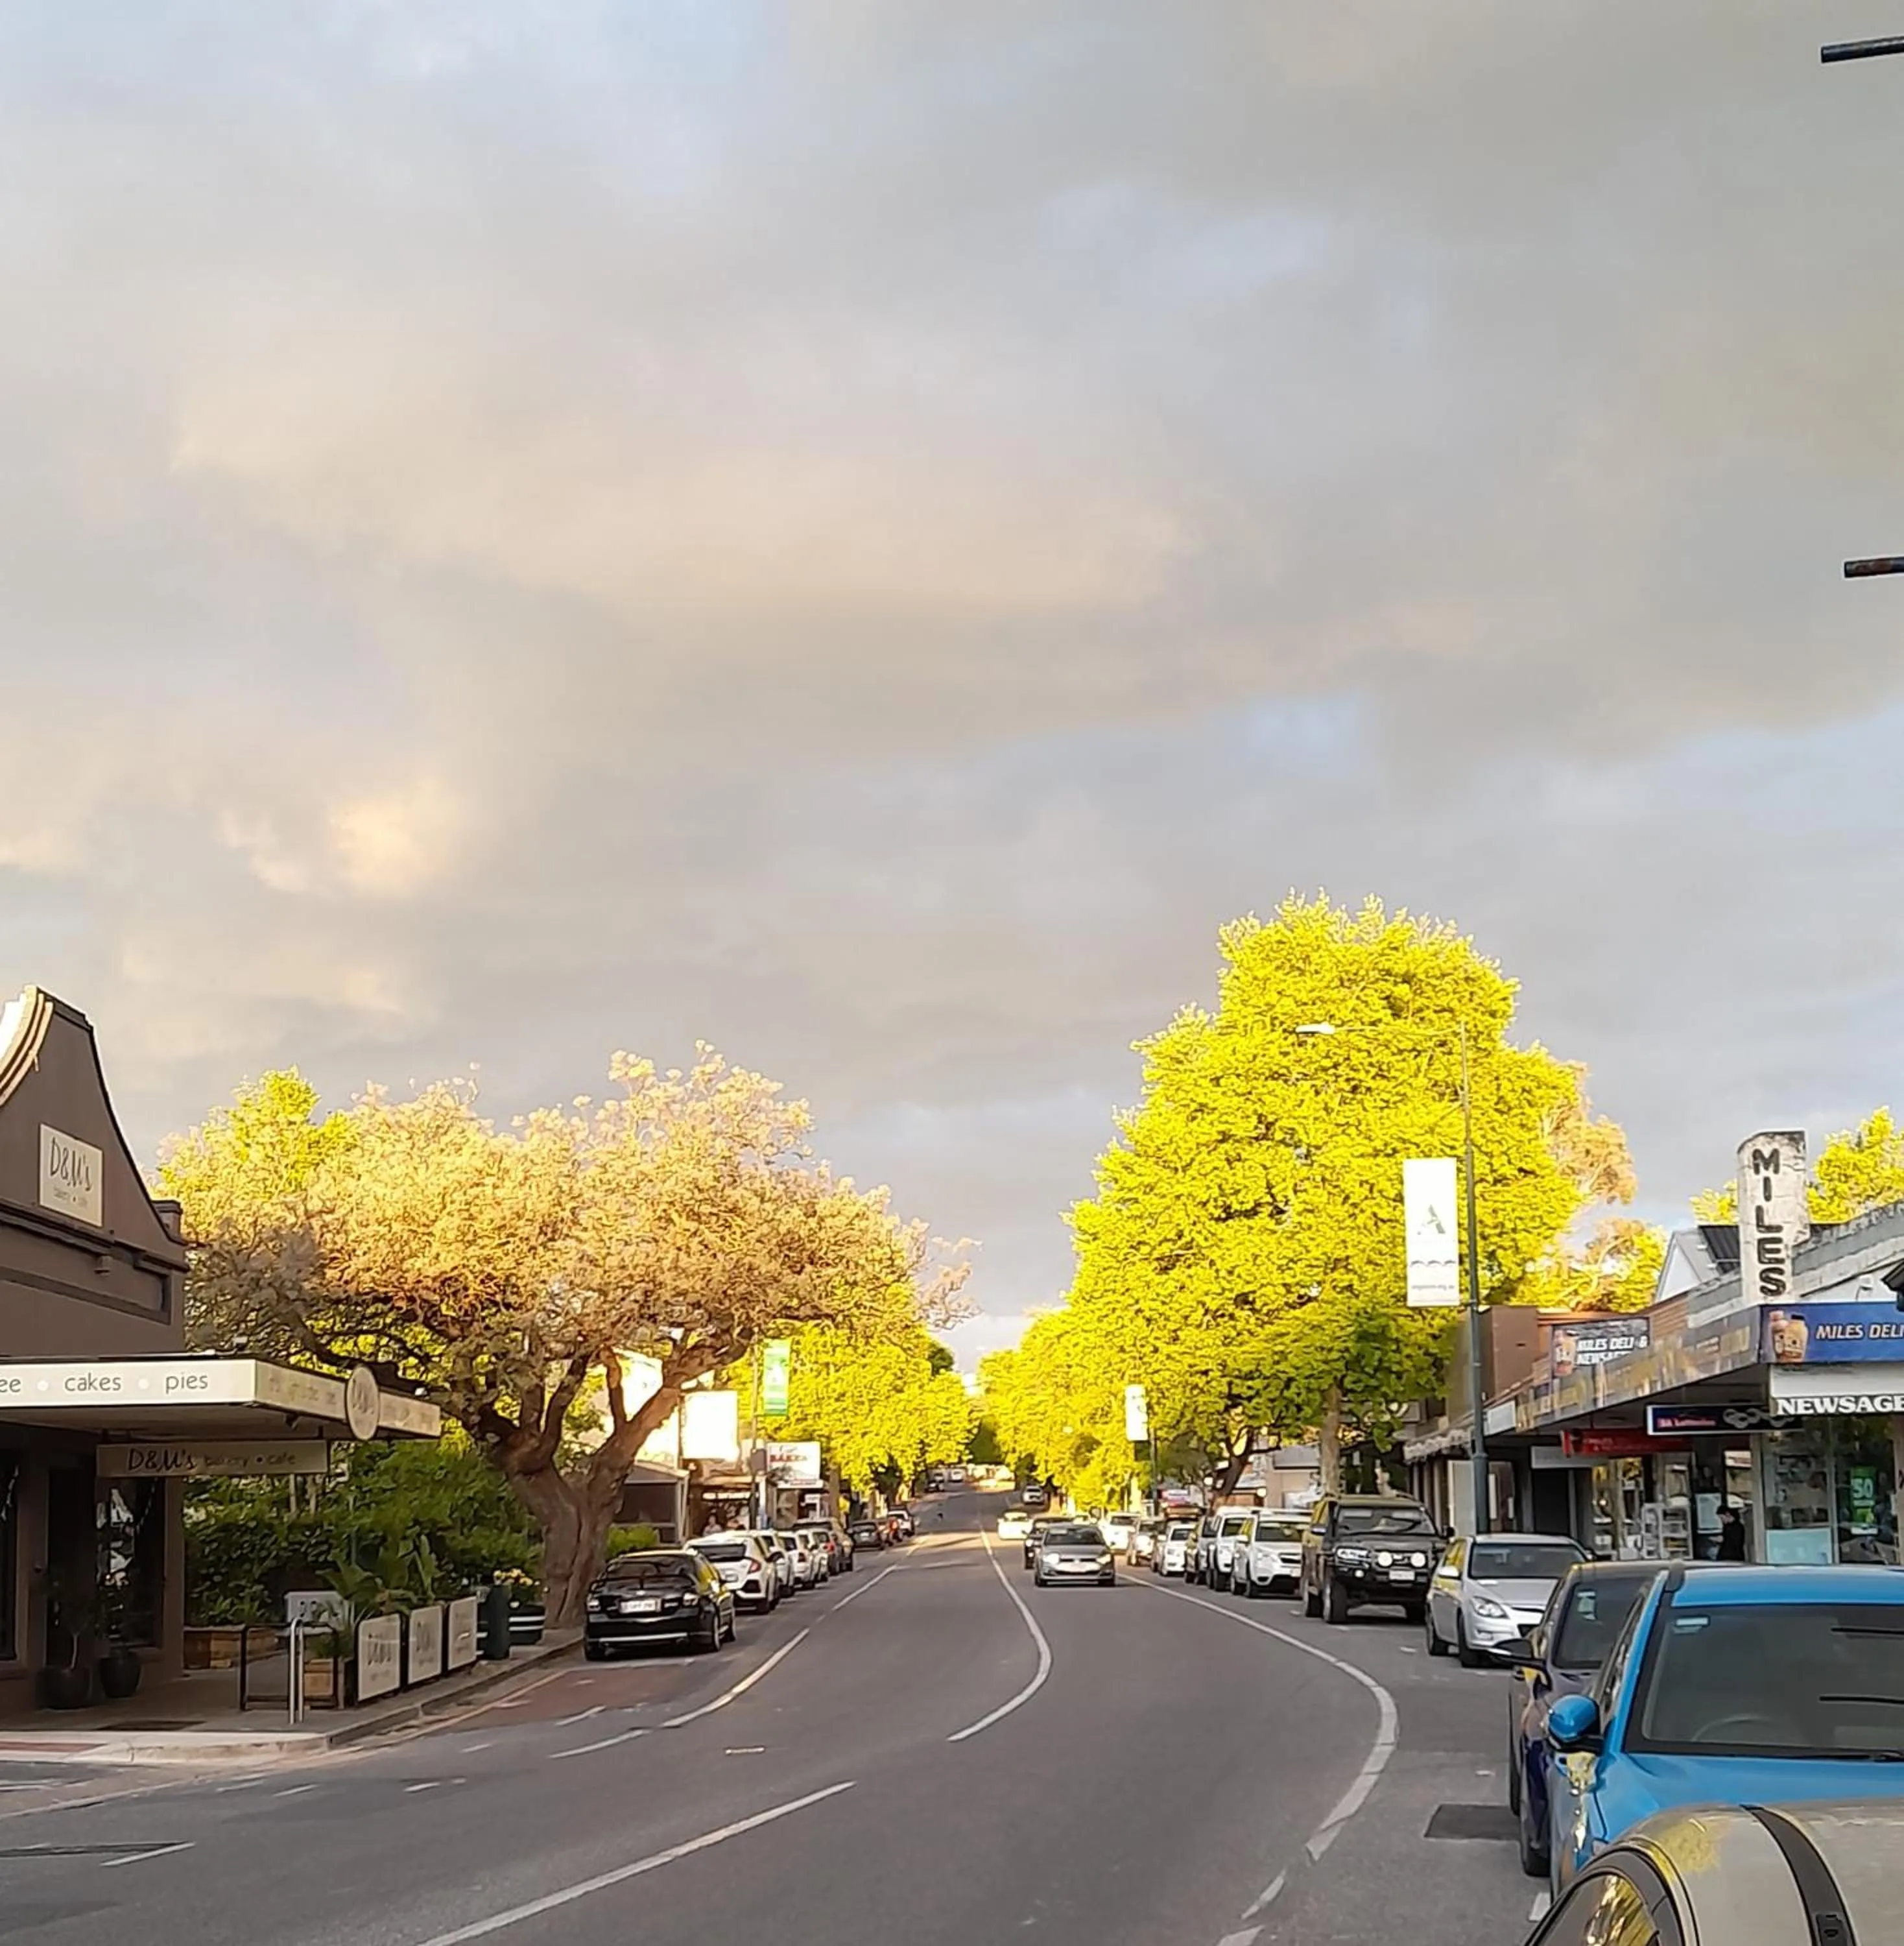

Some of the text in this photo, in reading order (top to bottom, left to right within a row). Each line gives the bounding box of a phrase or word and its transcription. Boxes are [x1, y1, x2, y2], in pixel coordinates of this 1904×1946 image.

[1752, 1147, 1787, 1297] MILES
[1815, 1324, 1904, 1340] MILES DELI
[64, 1372, 122, 1392] cakes
[165, 1374, 209, 1395] pies
[128, 1448, 197, 1471] D&M's
[1850, 1478, 1874, 1498] 50
